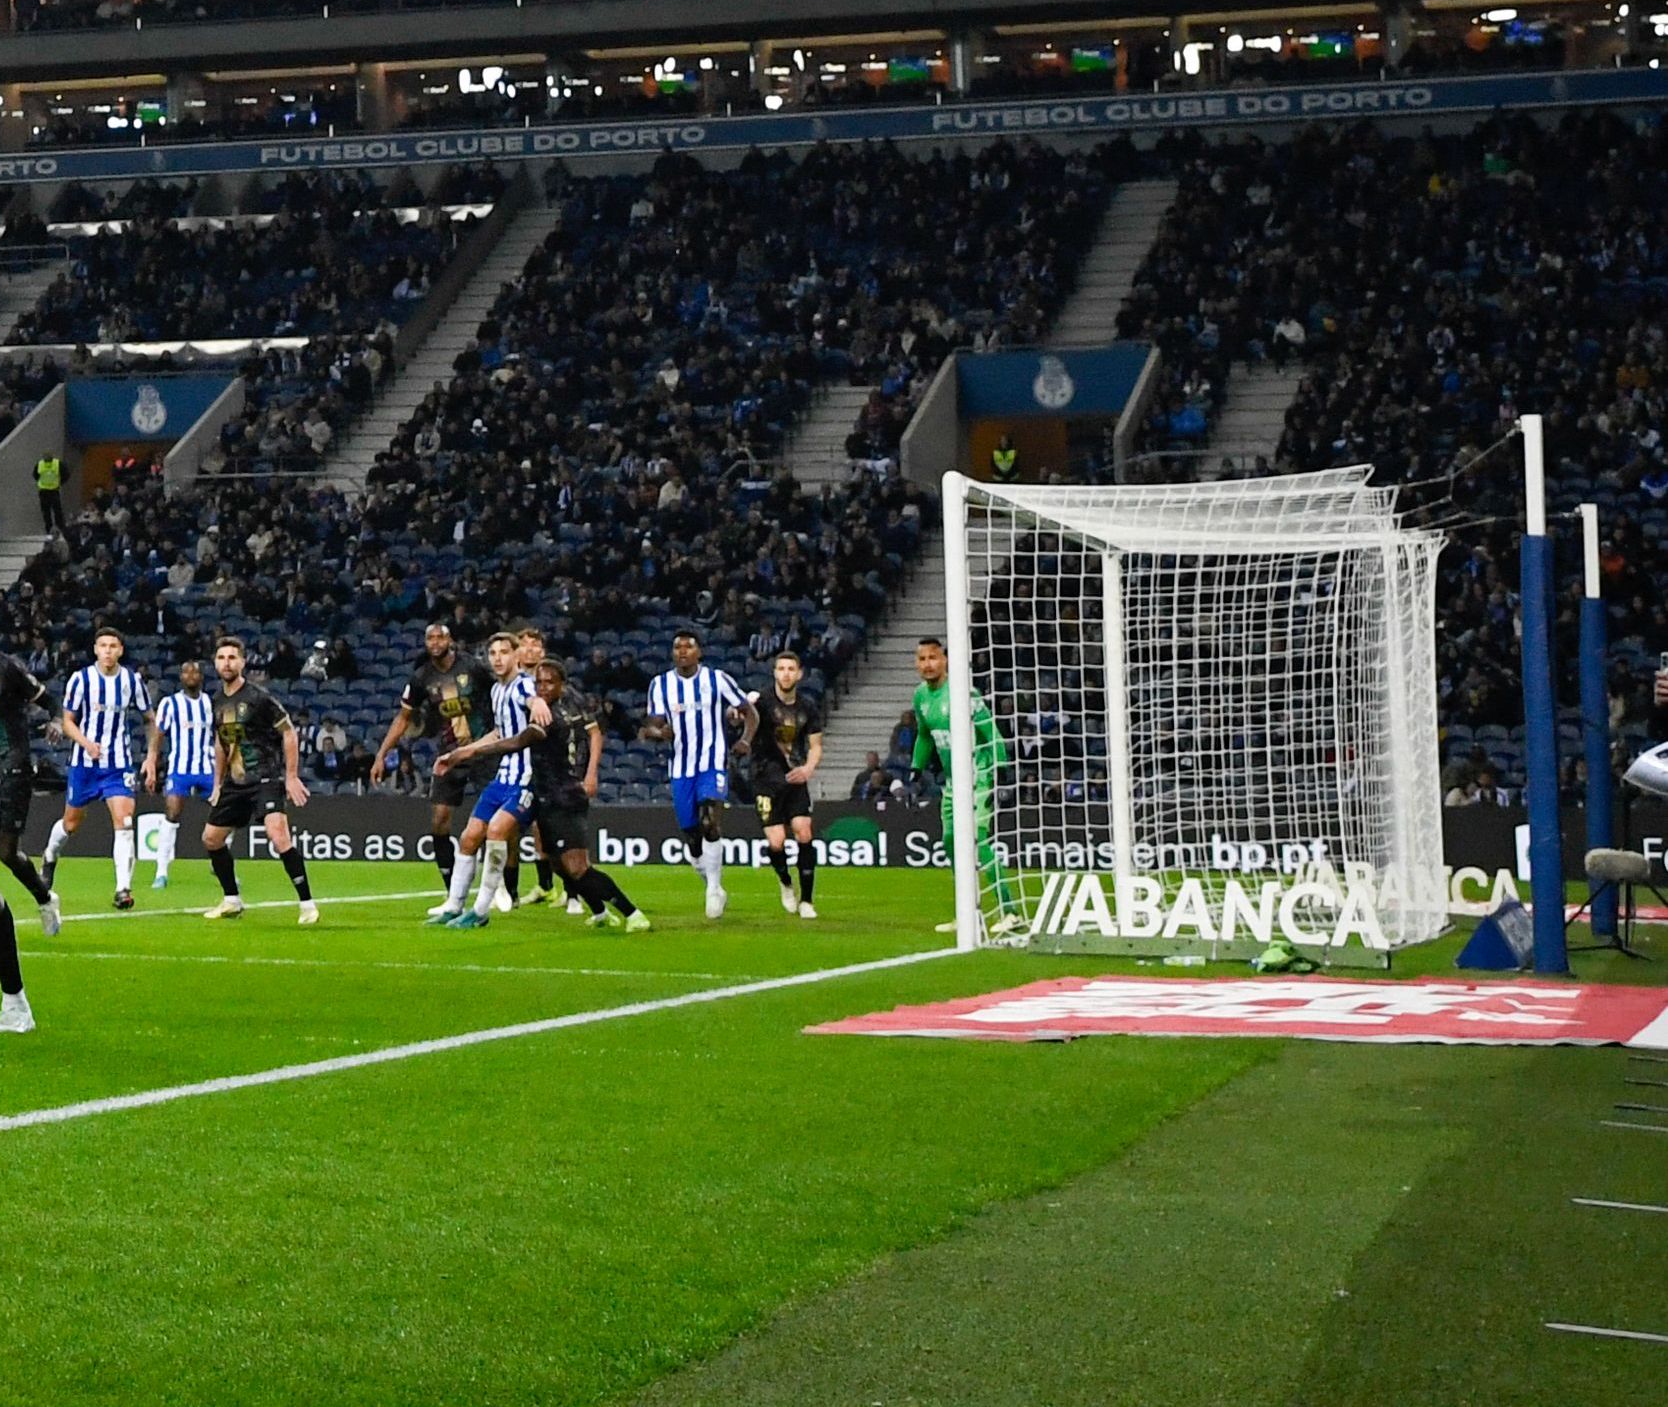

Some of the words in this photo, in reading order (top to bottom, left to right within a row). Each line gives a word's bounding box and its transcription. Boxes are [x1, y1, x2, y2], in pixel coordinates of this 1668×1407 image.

[932, 107, 1095, 131] FUTEBOL
[1105, 99, 1227, 120] CLUBE
[1237, 95, 1290, 114] DO
[1301, 88, 1433, 110] PORTO
[261, 140, 406, 164] FUTEBOL
[415, 135, 524, 155] CLUBE
[533, 132, 580, 152] DO
[588, 127, 706, 149] PORTO
[363, 832, 405, 861] as
[598, 828, 650, 867] bp
[906, 830, 1010, 869] Saa
[1025, 834, 1116, 869] mais
[1132, 842, 1197, 869] em
[1212, 833, 1329, 876] bp.pt
